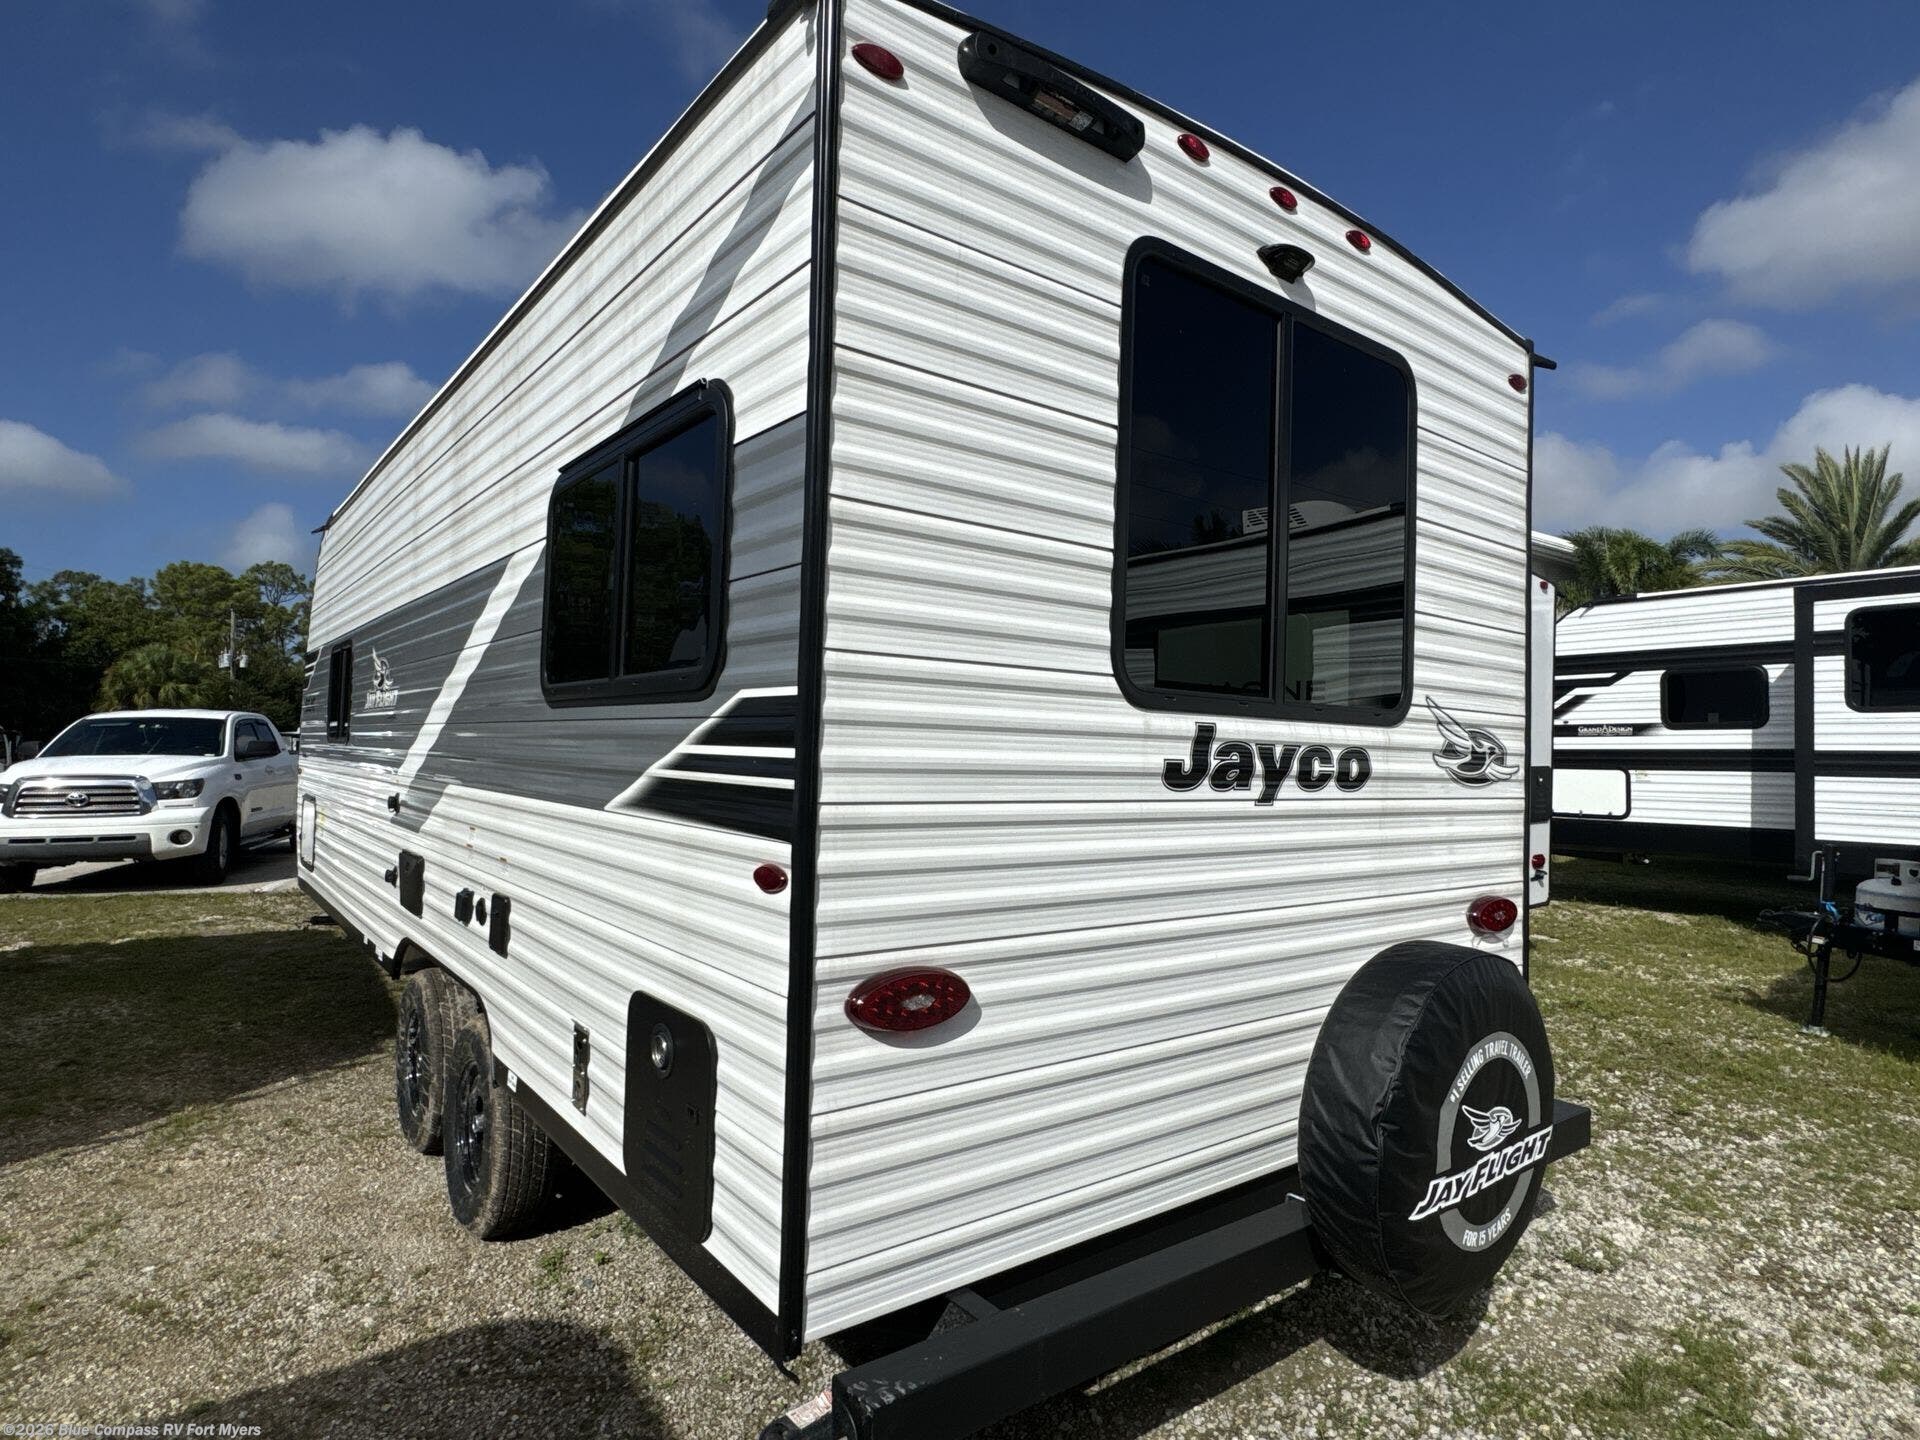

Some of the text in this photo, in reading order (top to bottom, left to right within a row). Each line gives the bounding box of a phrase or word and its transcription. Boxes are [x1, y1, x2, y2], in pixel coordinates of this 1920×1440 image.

[1161, 722, 1373, 806] Jayco
[1457, 1049, 1485, 1091] SELLING
[1484, 1040, 1508, 1059] TRAVEL
[1509, 1042, 1532, 1079] TRAILER
[1462, 1207, 1512, 1247] FOR 15 YEARS
